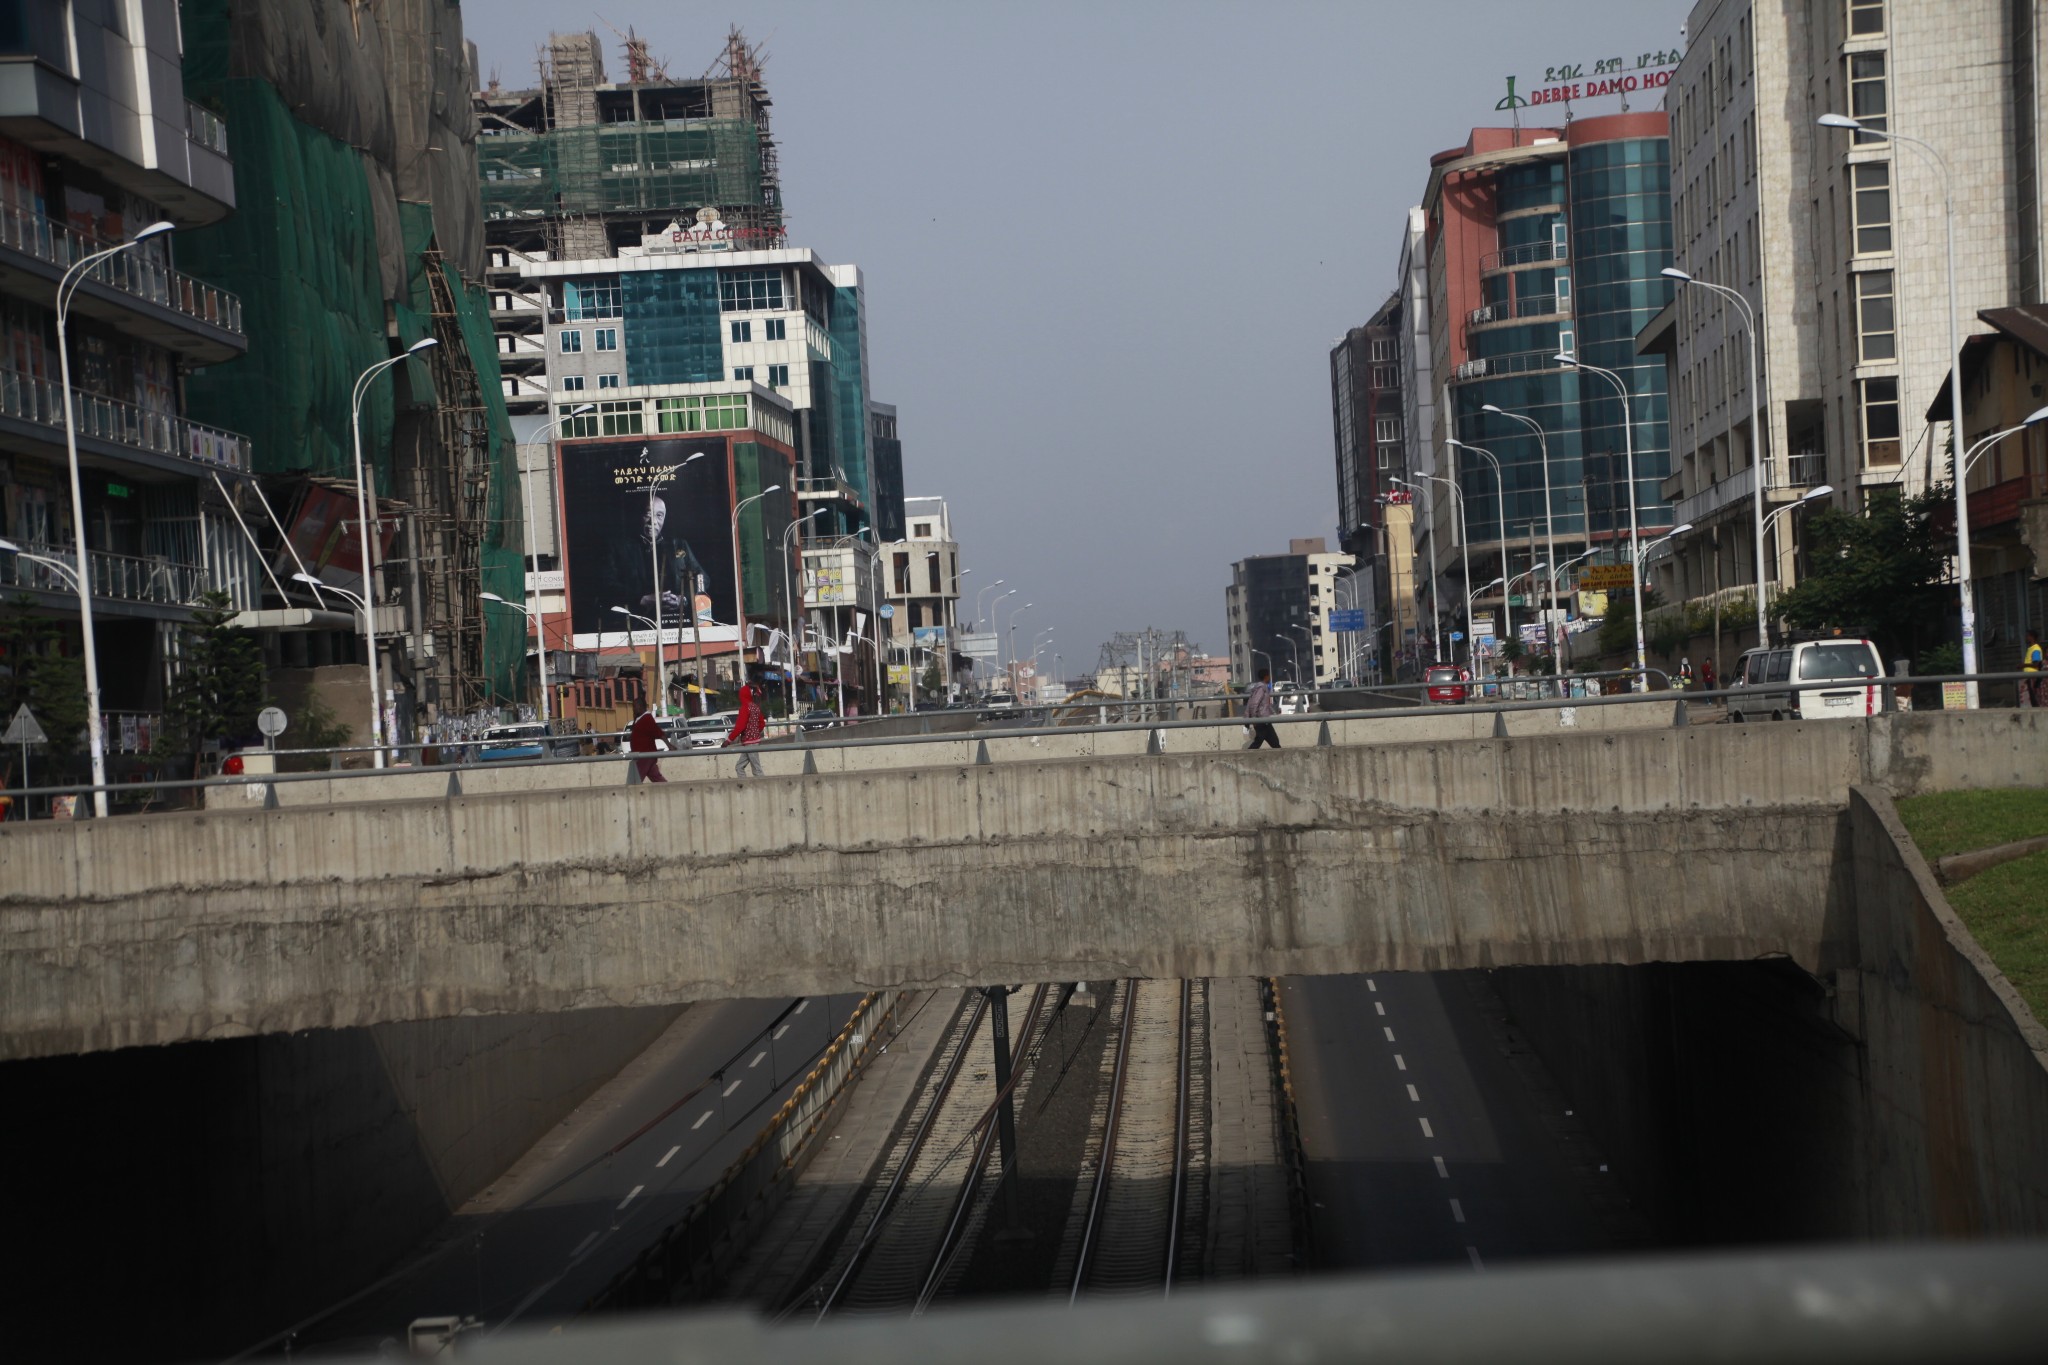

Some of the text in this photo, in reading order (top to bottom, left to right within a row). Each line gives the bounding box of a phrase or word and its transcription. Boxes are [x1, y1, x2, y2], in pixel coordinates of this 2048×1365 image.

[1544, 64, 1584, 82] ደብረ
[1637, 49, 1683, 68] ሆቴል
[1531, 83, 1580, 106] DEBRE
[1586, 75, 1637, 97] DAMO
[672, 225, 787, 243] BATA COMPLEX
